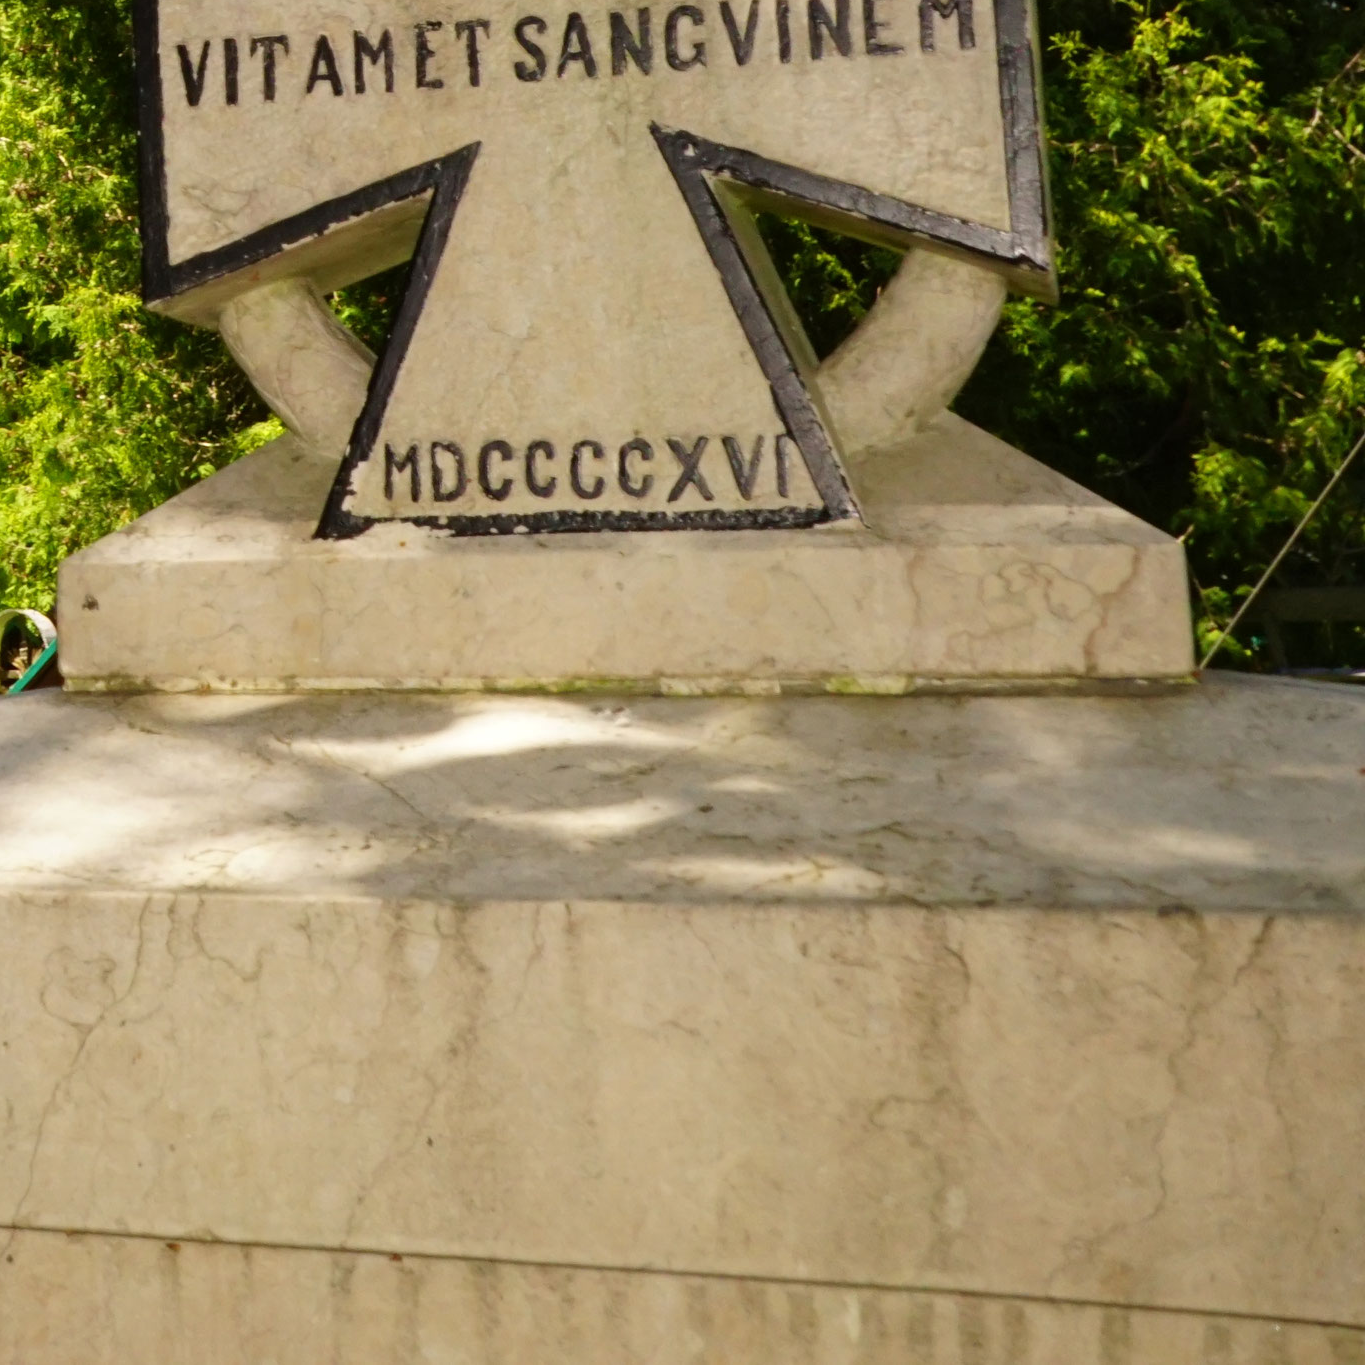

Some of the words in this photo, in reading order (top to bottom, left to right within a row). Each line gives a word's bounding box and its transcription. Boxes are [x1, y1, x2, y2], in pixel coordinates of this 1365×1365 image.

[176, 24, 397, 106] VITAM
[414, 18, 491, 88] ET
[382, 433, 801, 505] MDCCCCXVI
